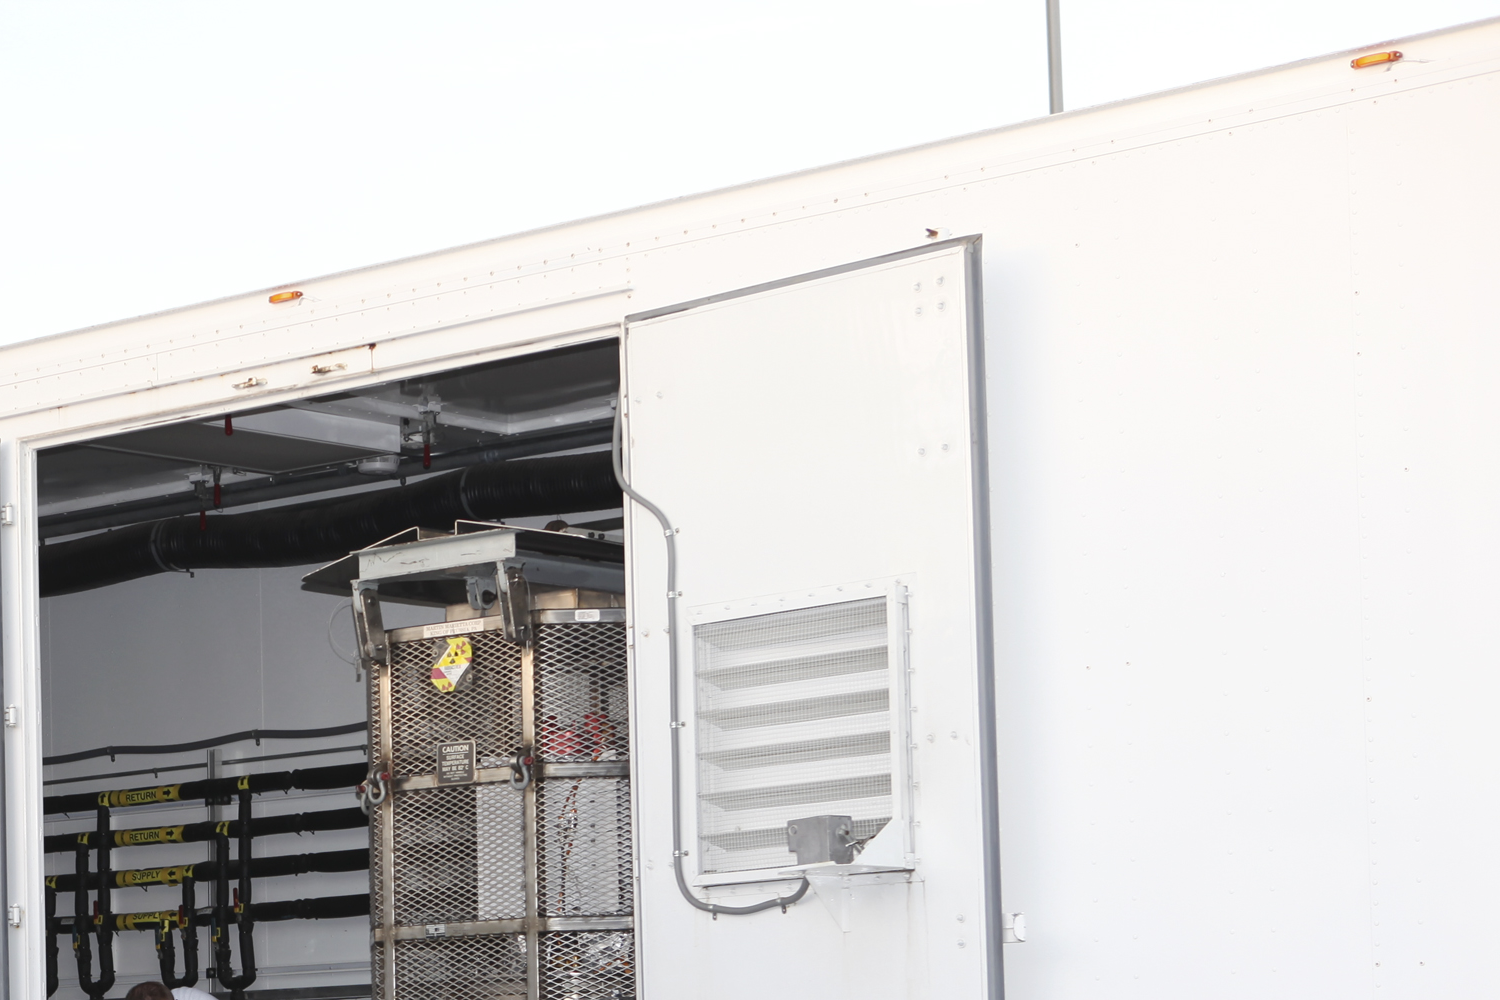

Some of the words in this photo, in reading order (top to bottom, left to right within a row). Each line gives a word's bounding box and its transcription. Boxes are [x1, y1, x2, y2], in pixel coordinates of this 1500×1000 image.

[442, 744, 469, 753] CAUTION
[125, 790, 157, 802] RETURN
[129, 830, 160, 842] RETURN
[131, 870, 161, 881] SUPPLY
[132, 911, 162, 920] SUPPLY
